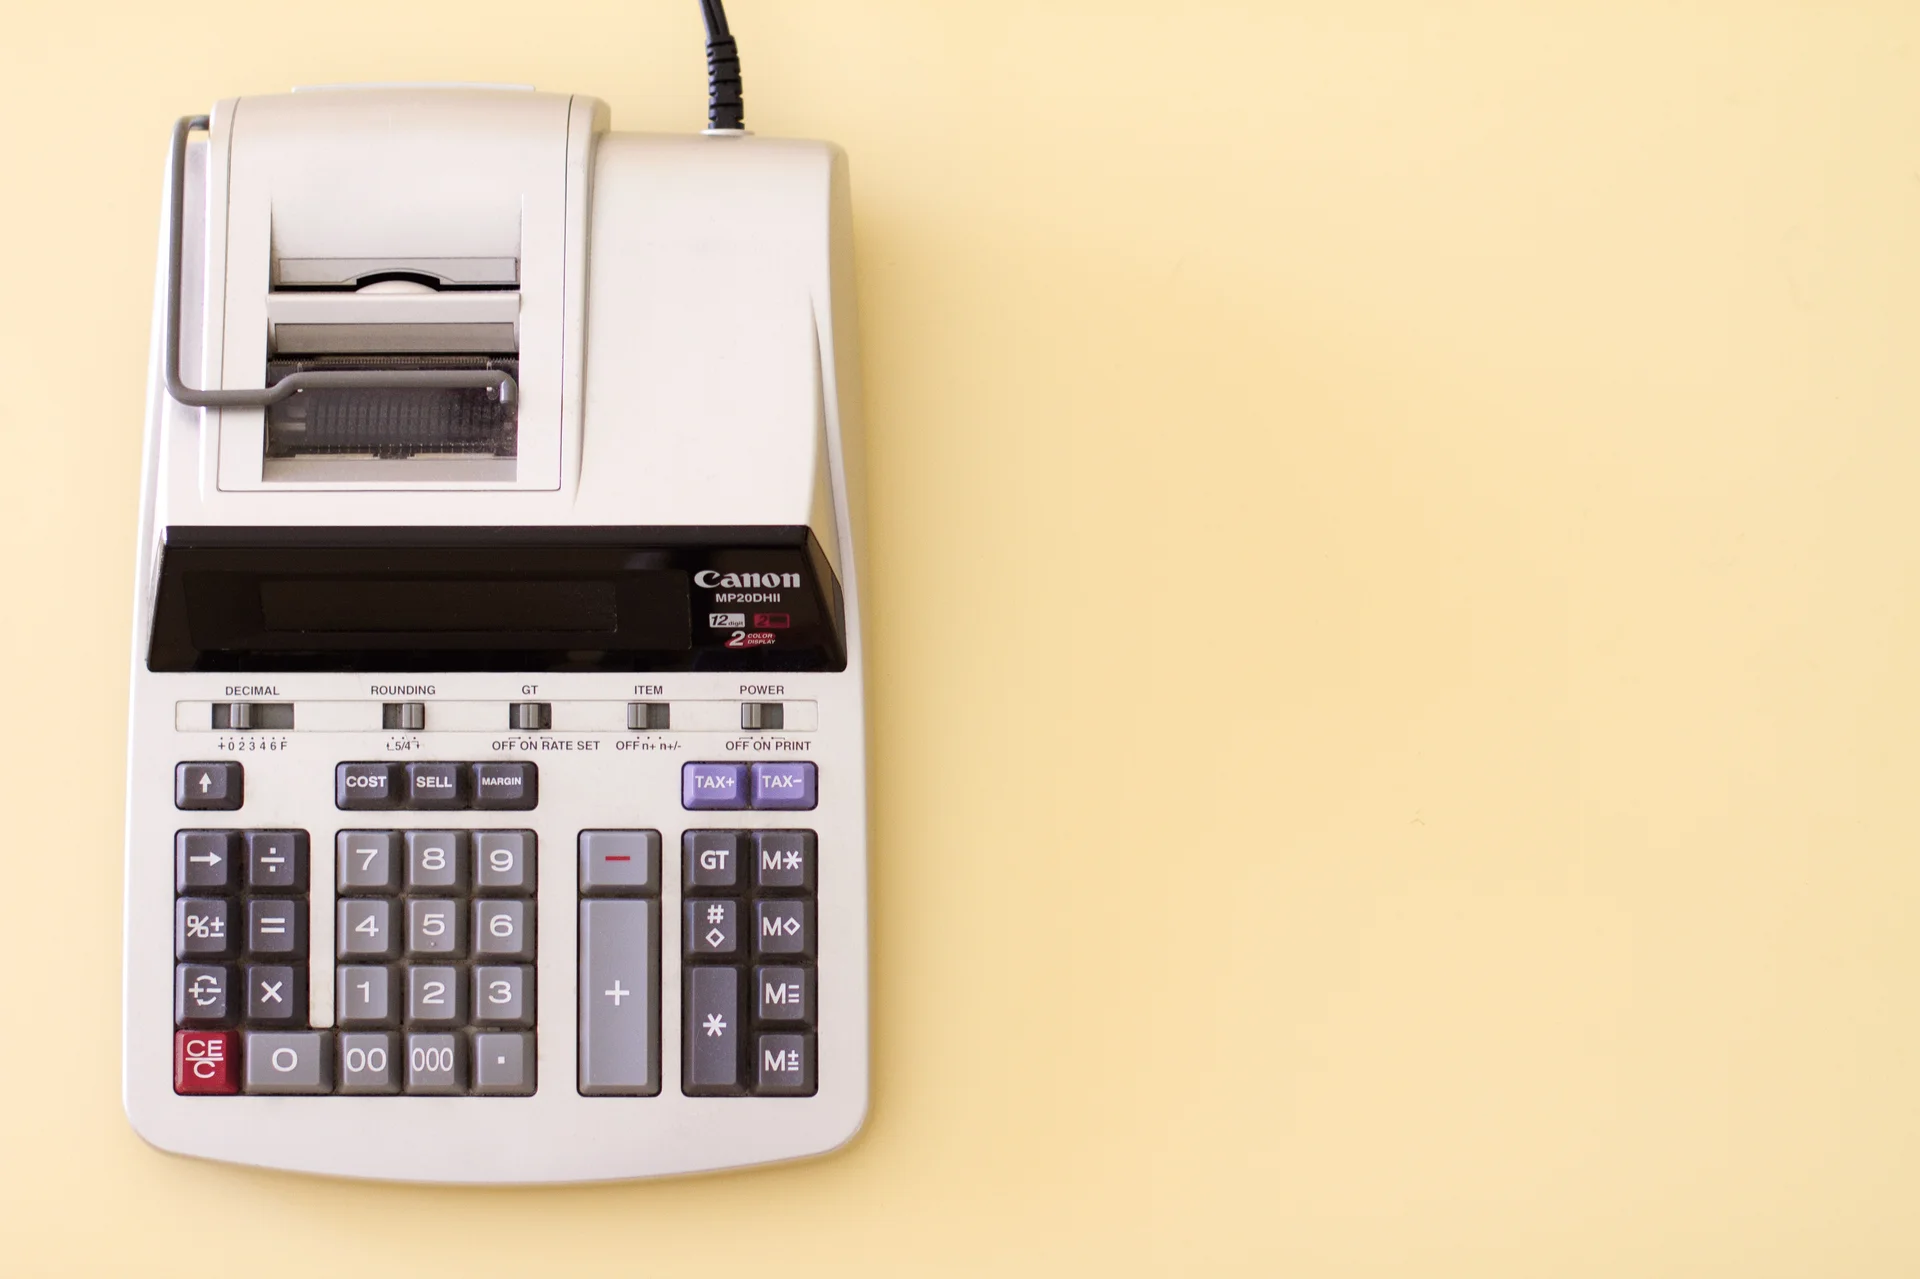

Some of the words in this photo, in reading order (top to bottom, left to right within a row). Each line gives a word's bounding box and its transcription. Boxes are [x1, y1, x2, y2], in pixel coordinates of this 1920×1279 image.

[694, 570, 801, 588] Canon
[715, 593, 781, 603] MP20DHII
[711, 615, 728, 626] 12
[729, 630, 746, 646] 2
[225, 686, 280, 696] DECIMAL
[370, 685, 436, 695] ROUNDING
[521, 685, 539, 695] GT
[634, 685, 663, 695] ITEM
[739, 685, 785, 695] POWER
[228, 741, 235, 751] 0
[238, 741, 246, 751] 2
[249, 741, 256, 751] 3
[259, 741, 266, 750] 4
[270, 741, 277, 751] 6
[280, 741, 288, 750] F
[491, 741, 516, 751] OFF
[519, 741, 538, 751] ON
[541, 741, 573, 751] RATE
[577, 741, 600, 751] SET
[615, 741, 640, 751] OFF
[725, 741, 750, 751] OFF
[753, 741, 771, 751] ON
[775, 741, 811, 751] PRINT
[346, 775, 387, 788] COST
[415, 776, 453, 788] SELL
[481, 777, 522, 786] MARGIN
[695, 775, 735, 788] TAX+
[762, 775, 803, 788] TAX-
[356, 849, 379, 871] 7
[422, 848, 446, 870] 8
[489, 850, 514, 872] 9
[700, 850, 730, 870] GT
[355, 915, 379, 937] 4
[422, 914, 446, 935] 5
[489, 915, 514, 937] 6
[356, 982, 370, 1003] 1
[422, 982, 446, 1004] 2
[488, 981, 512, 1004] 3
[186, 1039, 223, 1057] CE
[346, 1048, 387, 1072] 00
[411, 1048, 454, 1071] 000
[193, 1061, 216, 1079] C
